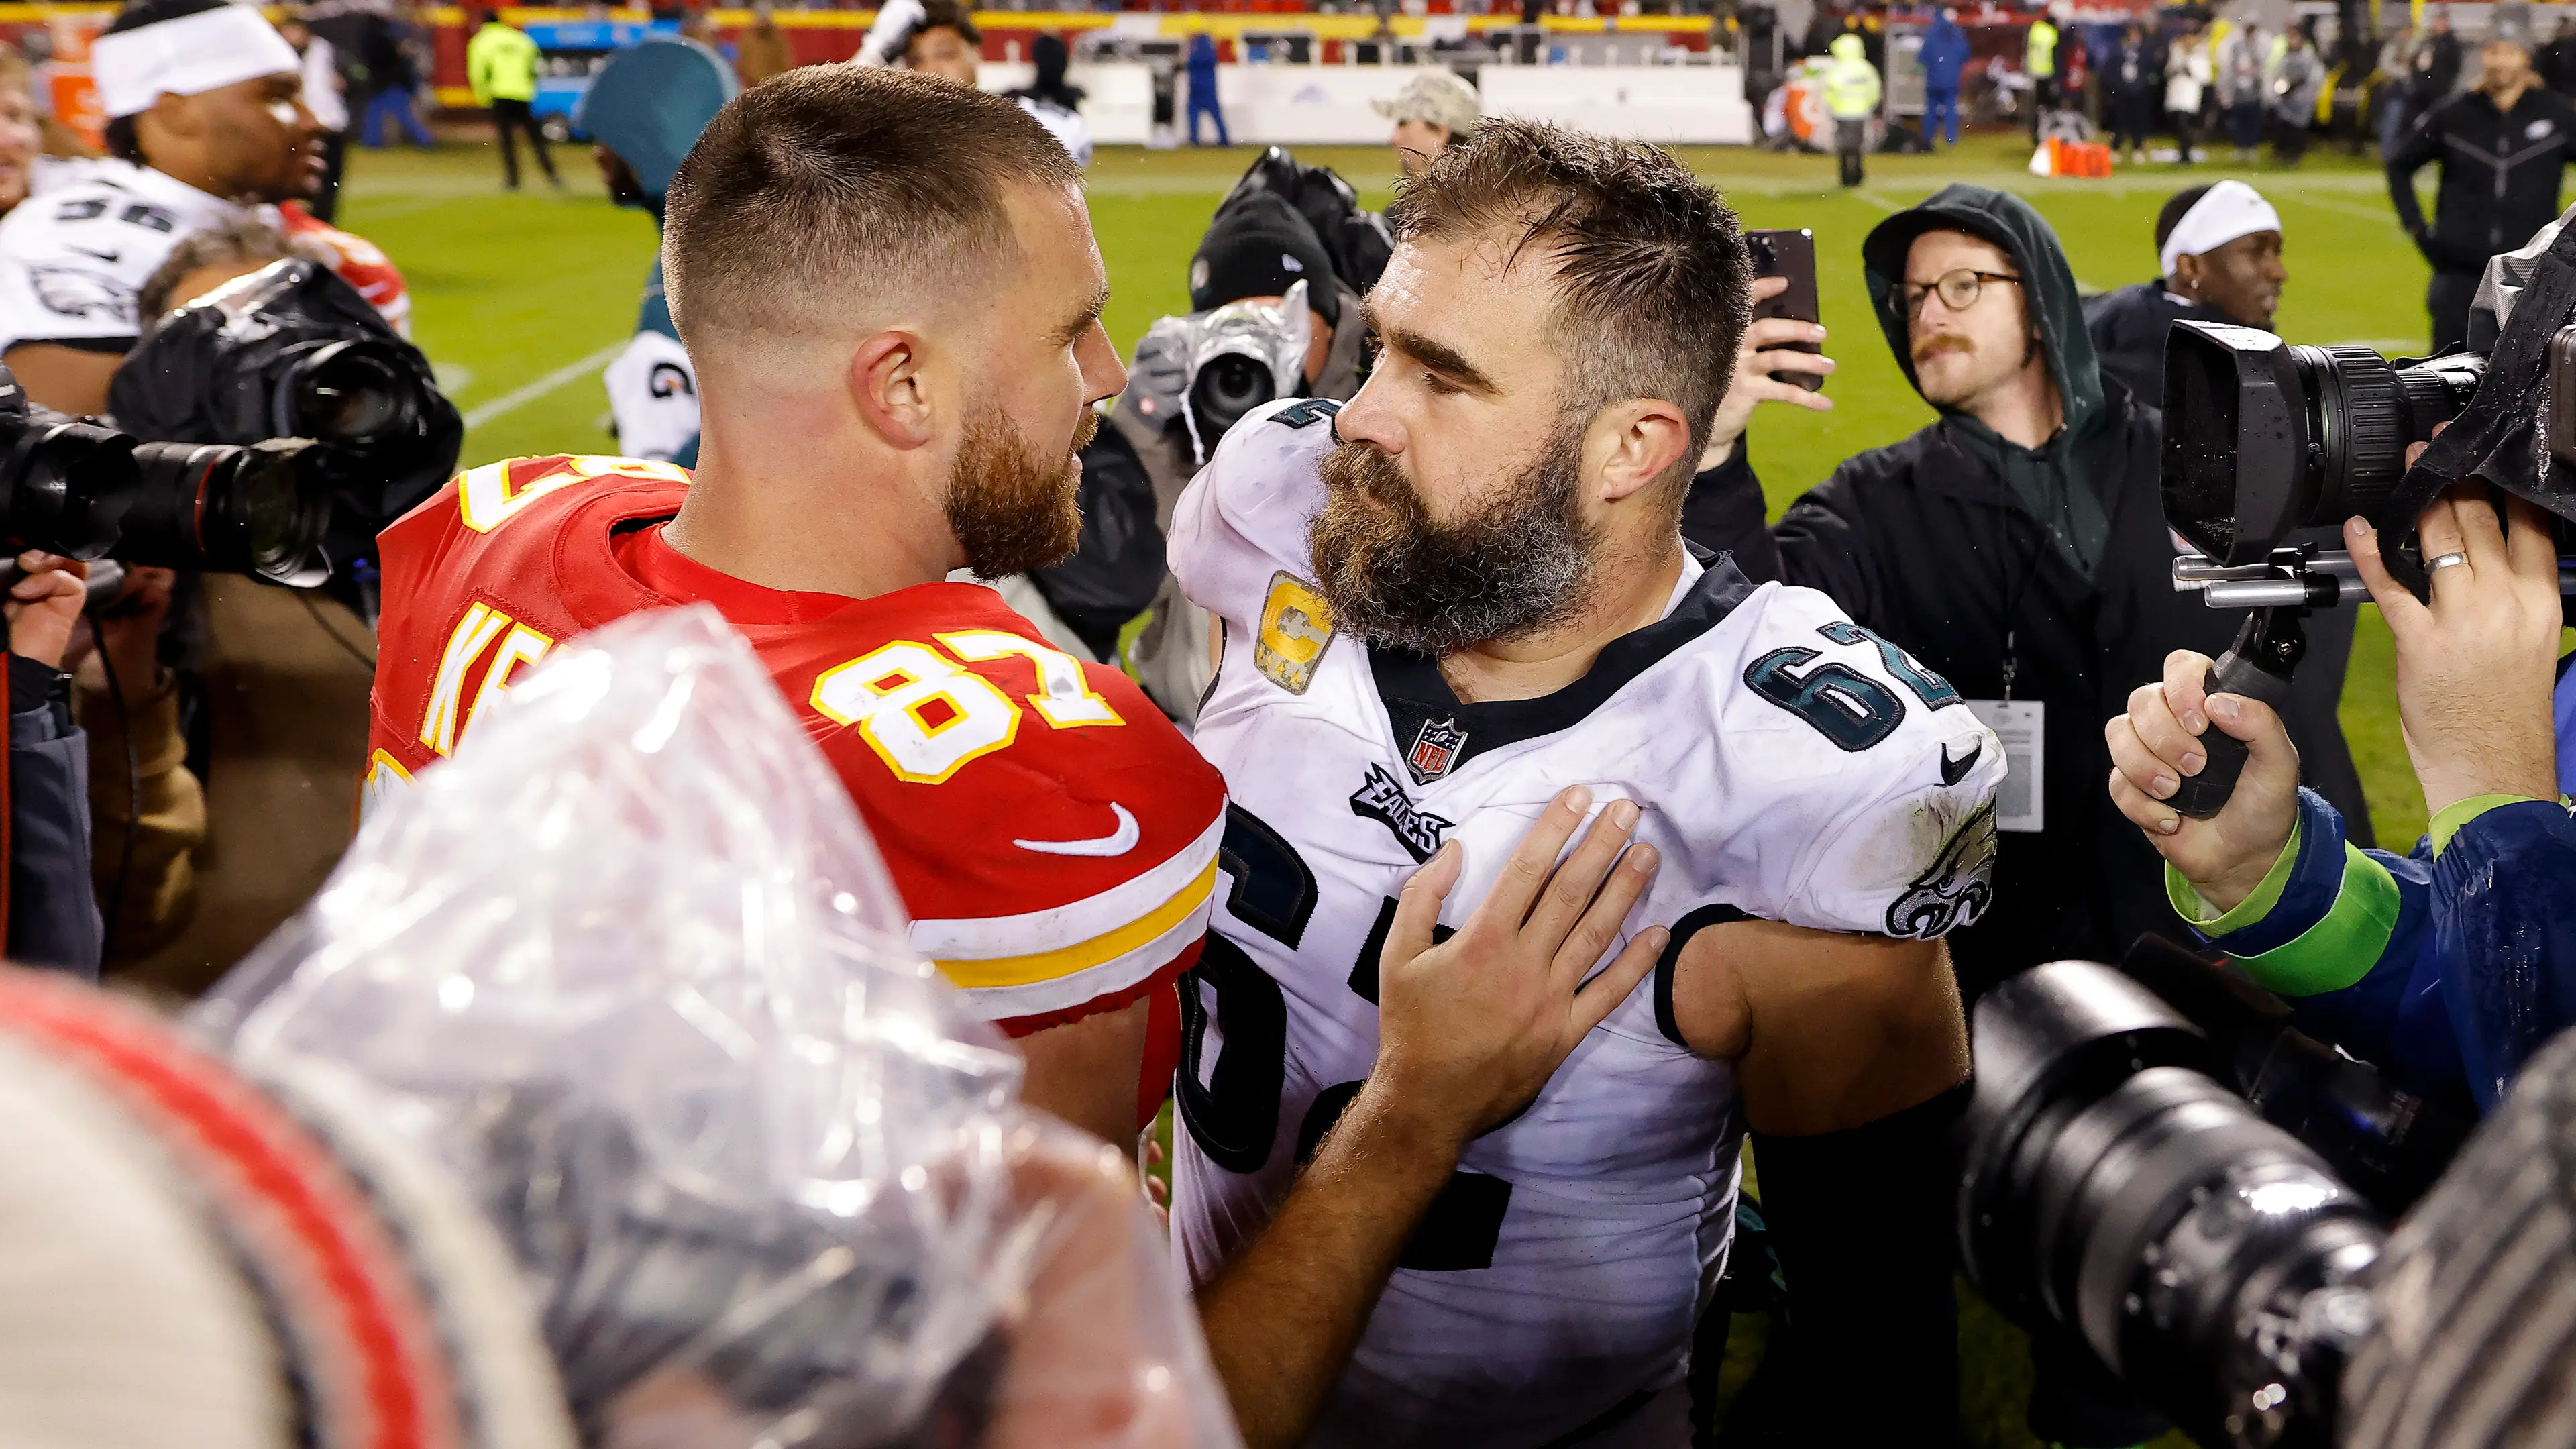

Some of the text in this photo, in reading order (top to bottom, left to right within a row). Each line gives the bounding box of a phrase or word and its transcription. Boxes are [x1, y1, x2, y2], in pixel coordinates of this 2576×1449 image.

[1260, 582, 1337, 665] C
[809, 629, 1127, 785] 87
[1743, 621, 1966, 753] 62
[1412, 741, 1449, 772] NFL
